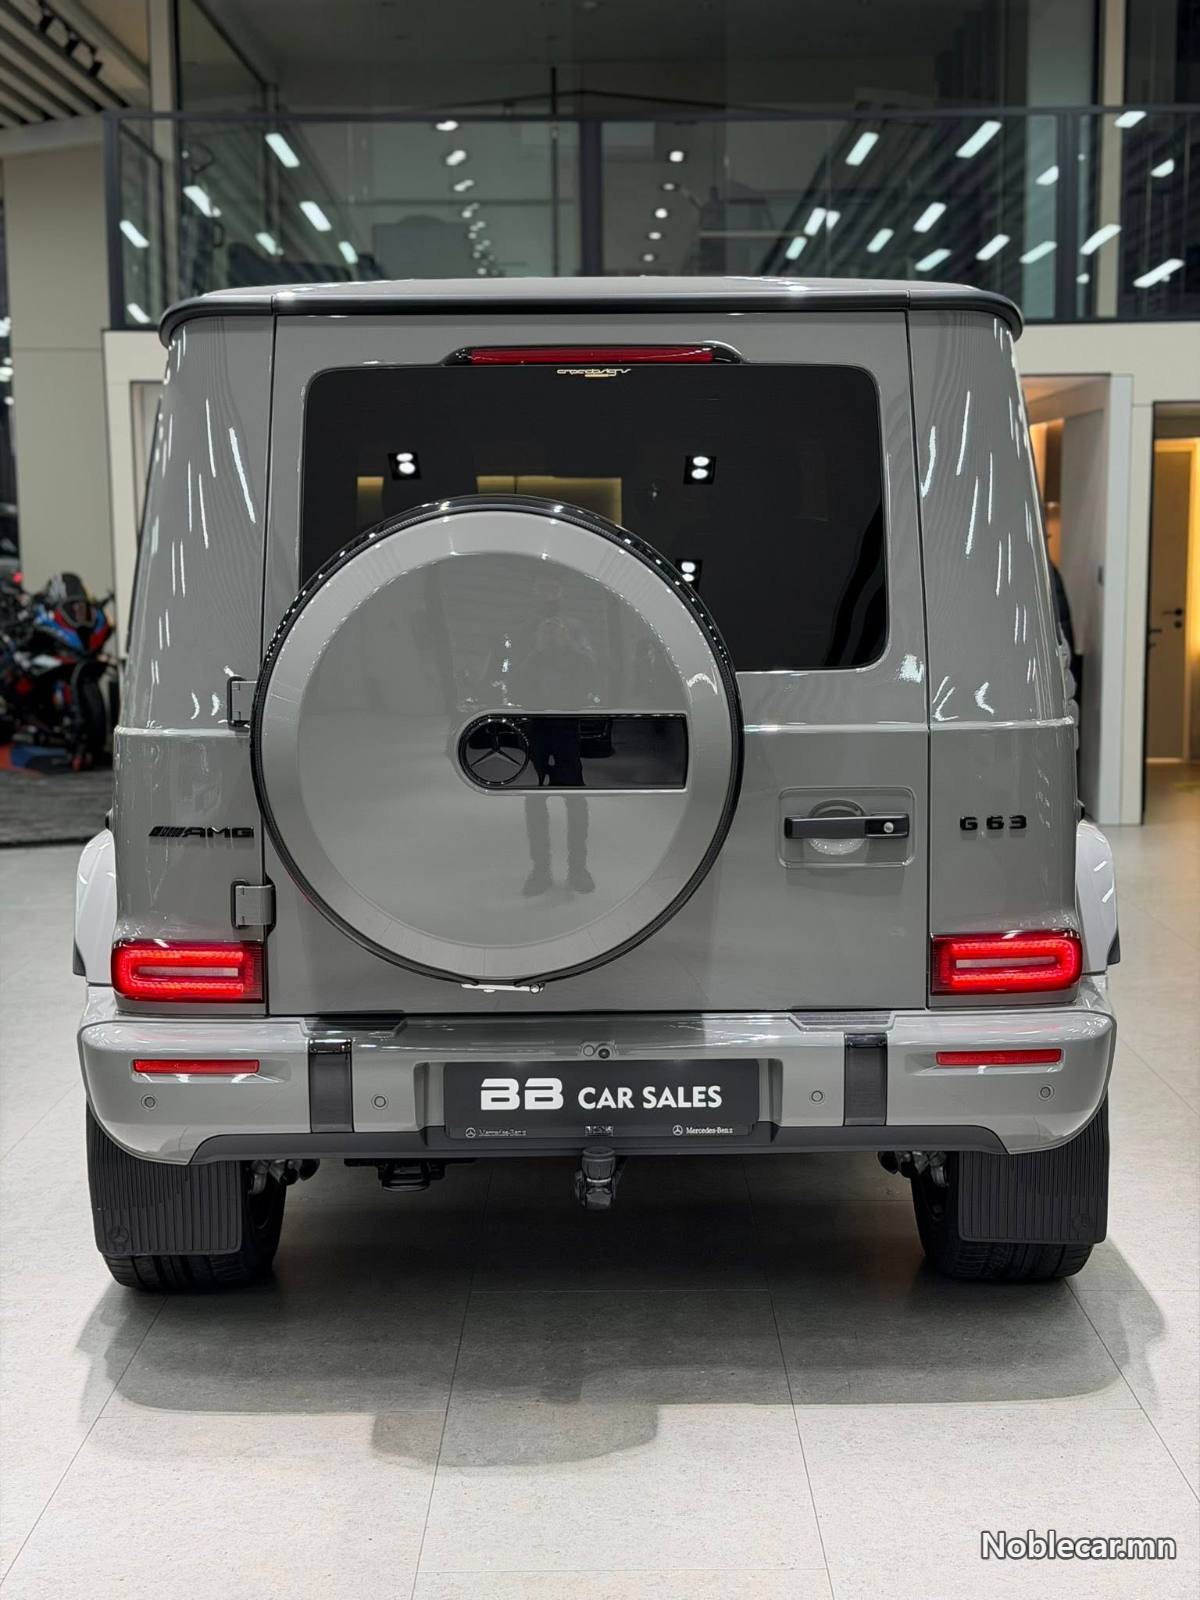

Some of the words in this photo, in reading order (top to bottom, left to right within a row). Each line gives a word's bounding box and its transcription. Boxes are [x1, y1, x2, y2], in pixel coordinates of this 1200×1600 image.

[181, 826, 254, 838] AMG
[480, 1077, 564, 1111] BB
[578, 1086, 634, 1109] CAR
[643, 1085, 722, 1109] SALES
[686, 1126, 734, 1135] Mercedes-Benz
